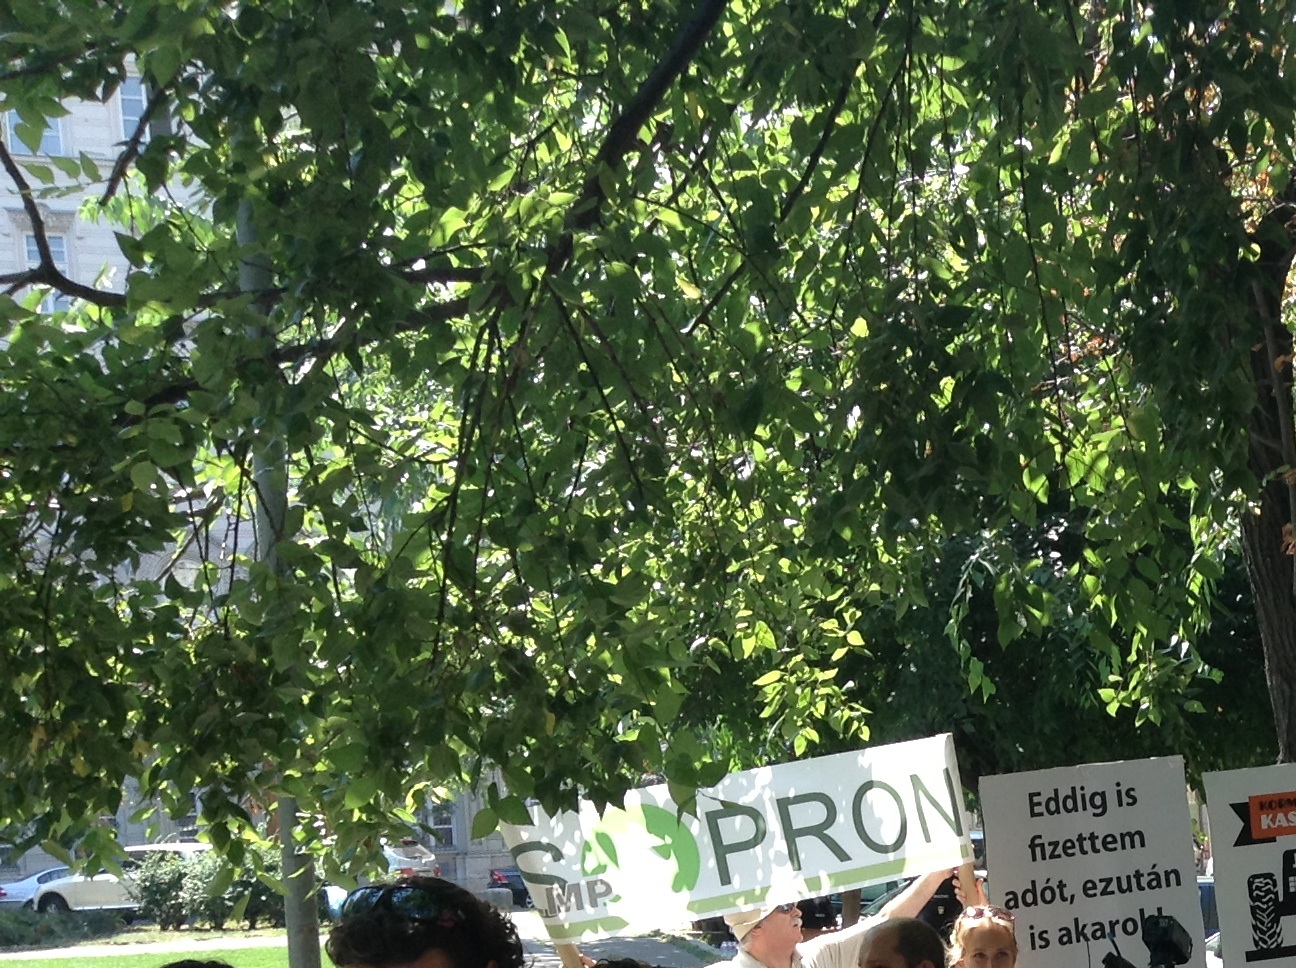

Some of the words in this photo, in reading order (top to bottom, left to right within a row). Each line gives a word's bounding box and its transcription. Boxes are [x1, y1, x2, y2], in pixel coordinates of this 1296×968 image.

[1028, 786, 1107, 819] Eddig
[1115, 782, 1138, 808] is
[1028, 829, 1146, 862] fizettem
[1004, 877, 1076, 911] adót,
[1082, 863, 1182, 899] ezután
[1029, 924, 1051, 951] is
